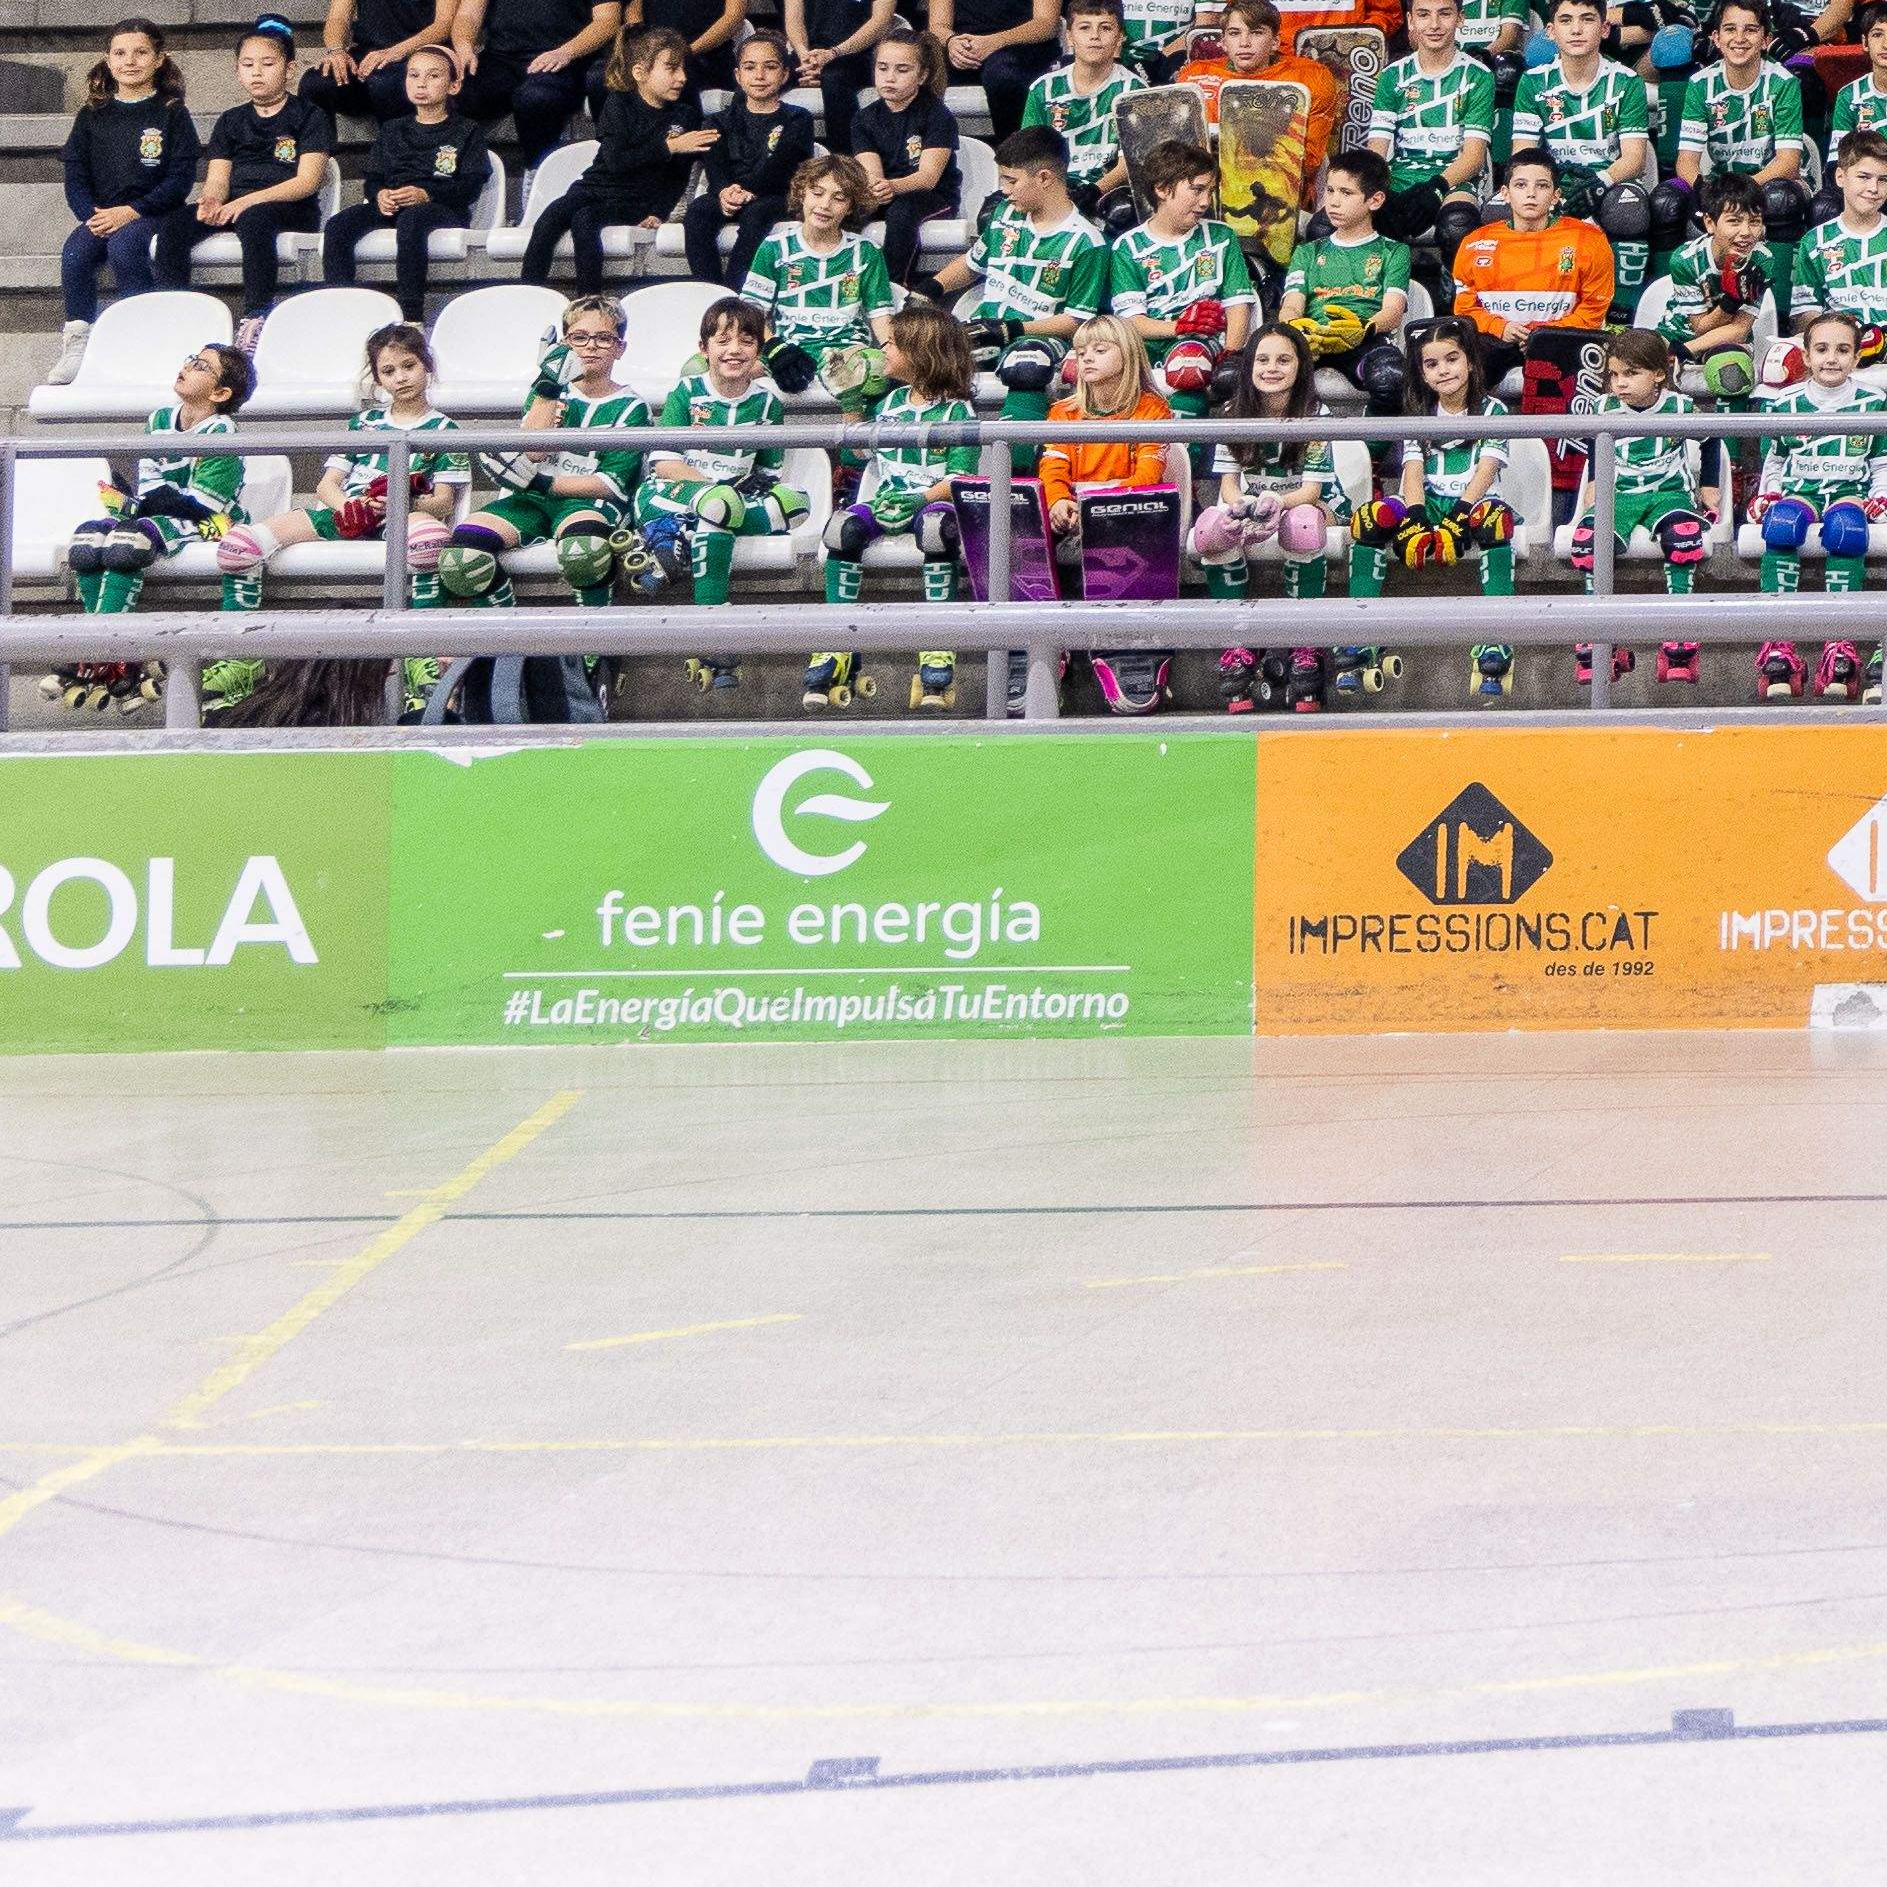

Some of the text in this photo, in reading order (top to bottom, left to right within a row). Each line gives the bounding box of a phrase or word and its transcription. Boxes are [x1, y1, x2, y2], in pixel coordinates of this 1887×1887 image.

[596, 888, 1041, 961] feníe energía
[1290, 912, 1658, 954] IMPRESSIONS.CAT
[1545, 962, 1654, 977] des de 1992
